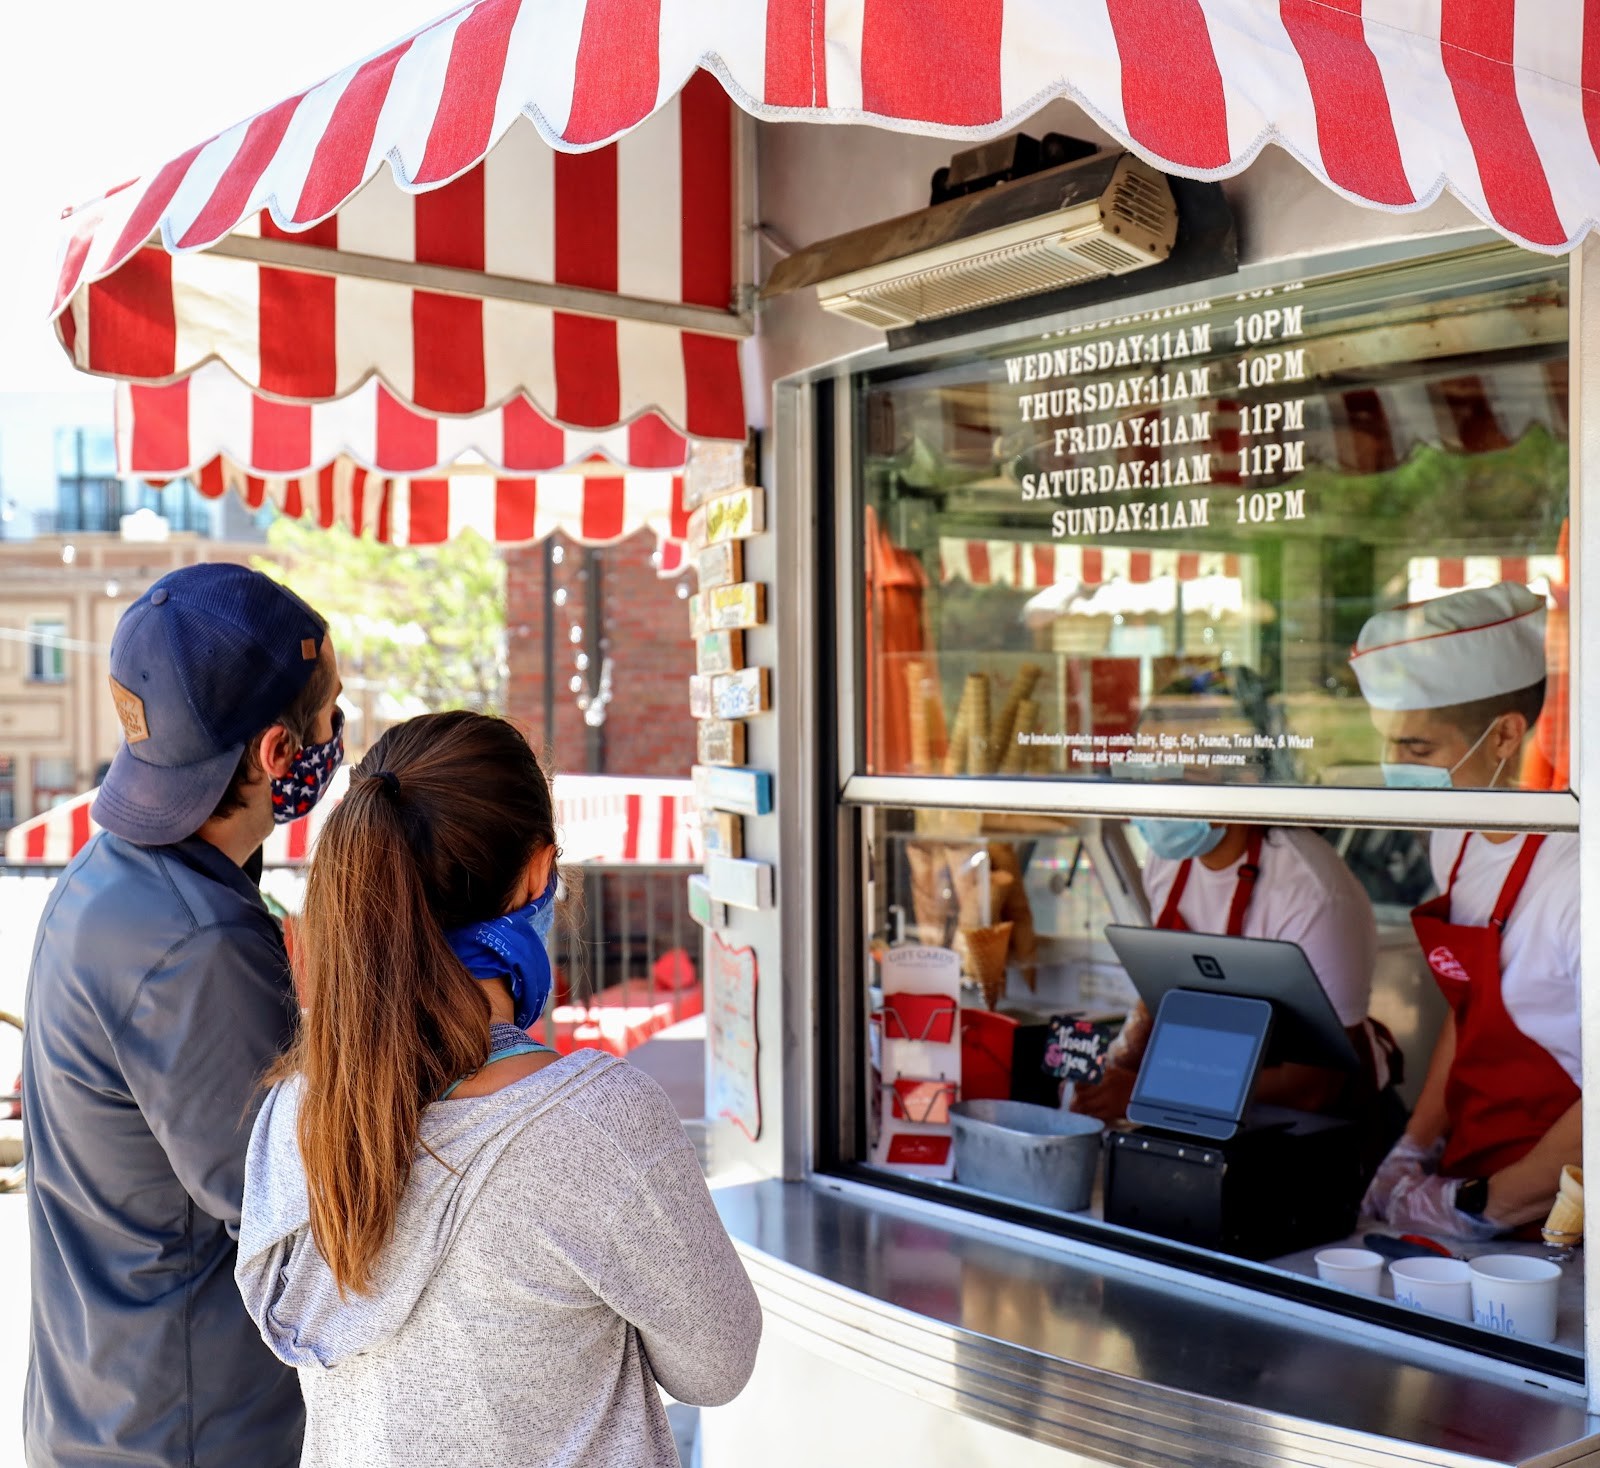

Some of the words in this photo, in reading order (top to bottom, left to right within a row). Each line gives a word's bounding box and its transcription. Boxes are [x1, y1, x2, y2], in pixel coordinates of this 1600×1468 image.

[1234, 305, 1304, 346] 10PM
[1237, 349, 1305, 389] 10PM
[1238, 400, 1305, 436] 11PM
[1238, 441, 1305, 476] 11PM
[1236, 489, 1306, 524] 10PM
[1018, 732, 1030, 745] Our
[1063, 733, 1092, 748] products
[1093, 735, 1107, 749] may
[1136, 733, 1158, 749] Dairy,
[1159, 732, 1179, 749] Eggs,
[1198, 733, 1232, 749] Peanuts,
[1233, 733, 1252, 748] Tree
[1253, 734, 1275, 750] Nuts,
[1277, 734, 1286, 748] &
[1287, 734, 1314, 748] Wheat
[1072, 749, 1094, 762] Please
[1095, 749, 1108, 762] ask
[1109, 751, 1125, 765] your
[1156, 750, 1162, 762] if
[1163, 752, 1177, 766] you
[1178, 751, 1195, 764] have
[1197, 753, 1210, 768] any
[475, 935, 505, 956] VODKA
[478, 928, 508, 952] KEEL
